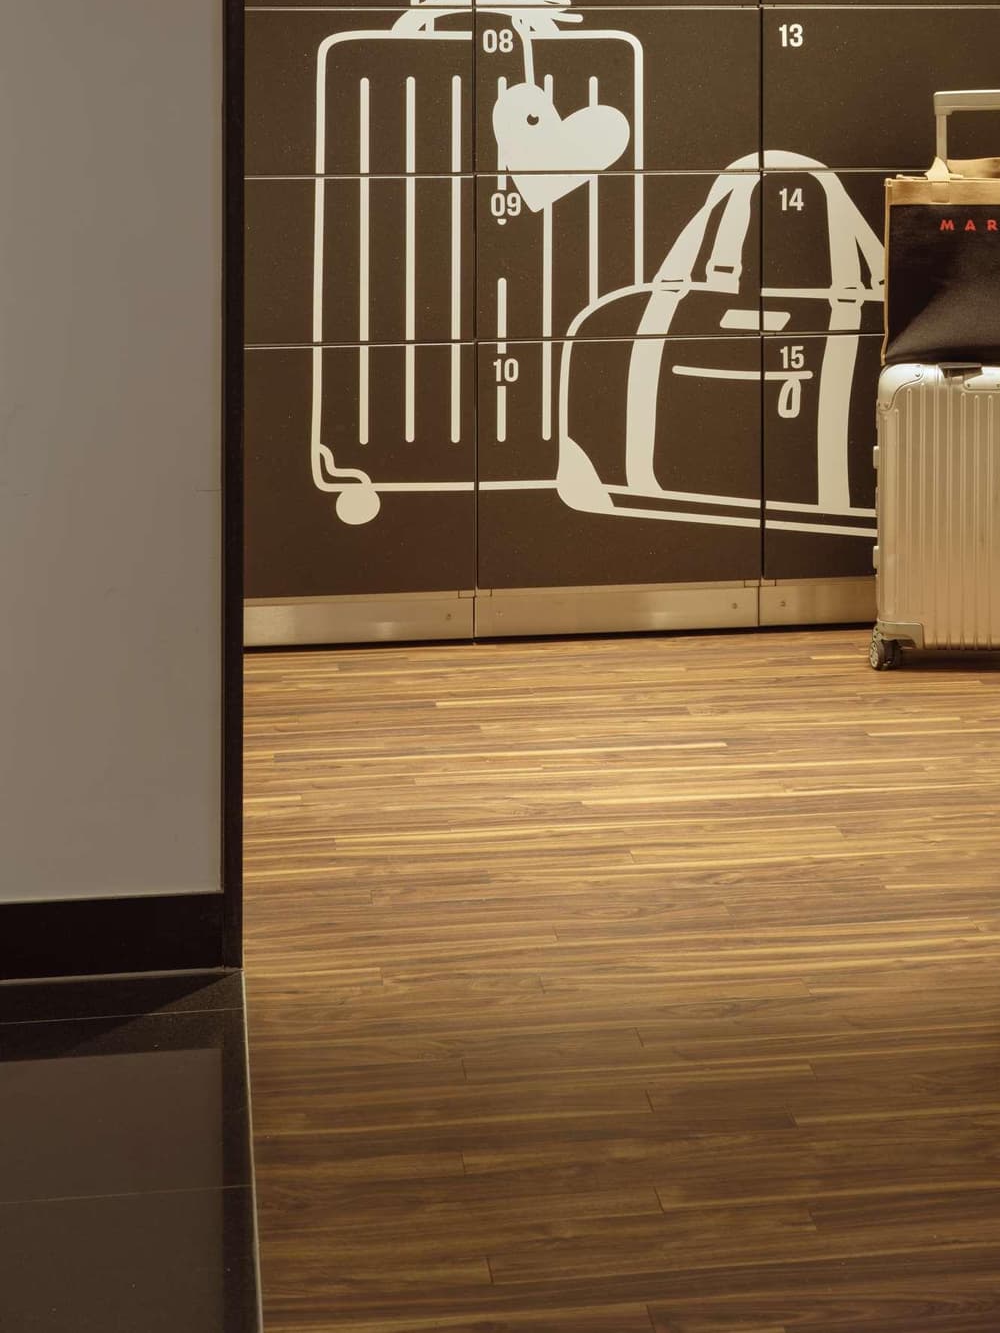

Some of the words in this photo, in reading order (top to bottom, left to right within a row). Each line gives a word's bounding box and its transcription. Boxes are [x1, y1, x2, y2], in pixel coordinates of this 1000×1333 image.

[482, 28, 514, 54] 08
[778, 23, 804, 48] 13
[490, 192, 521, 217] 09
[778, 187, 805, 211] 14
[779, 345, 805, 369] 15
[492, 357, 519, 383] 10
